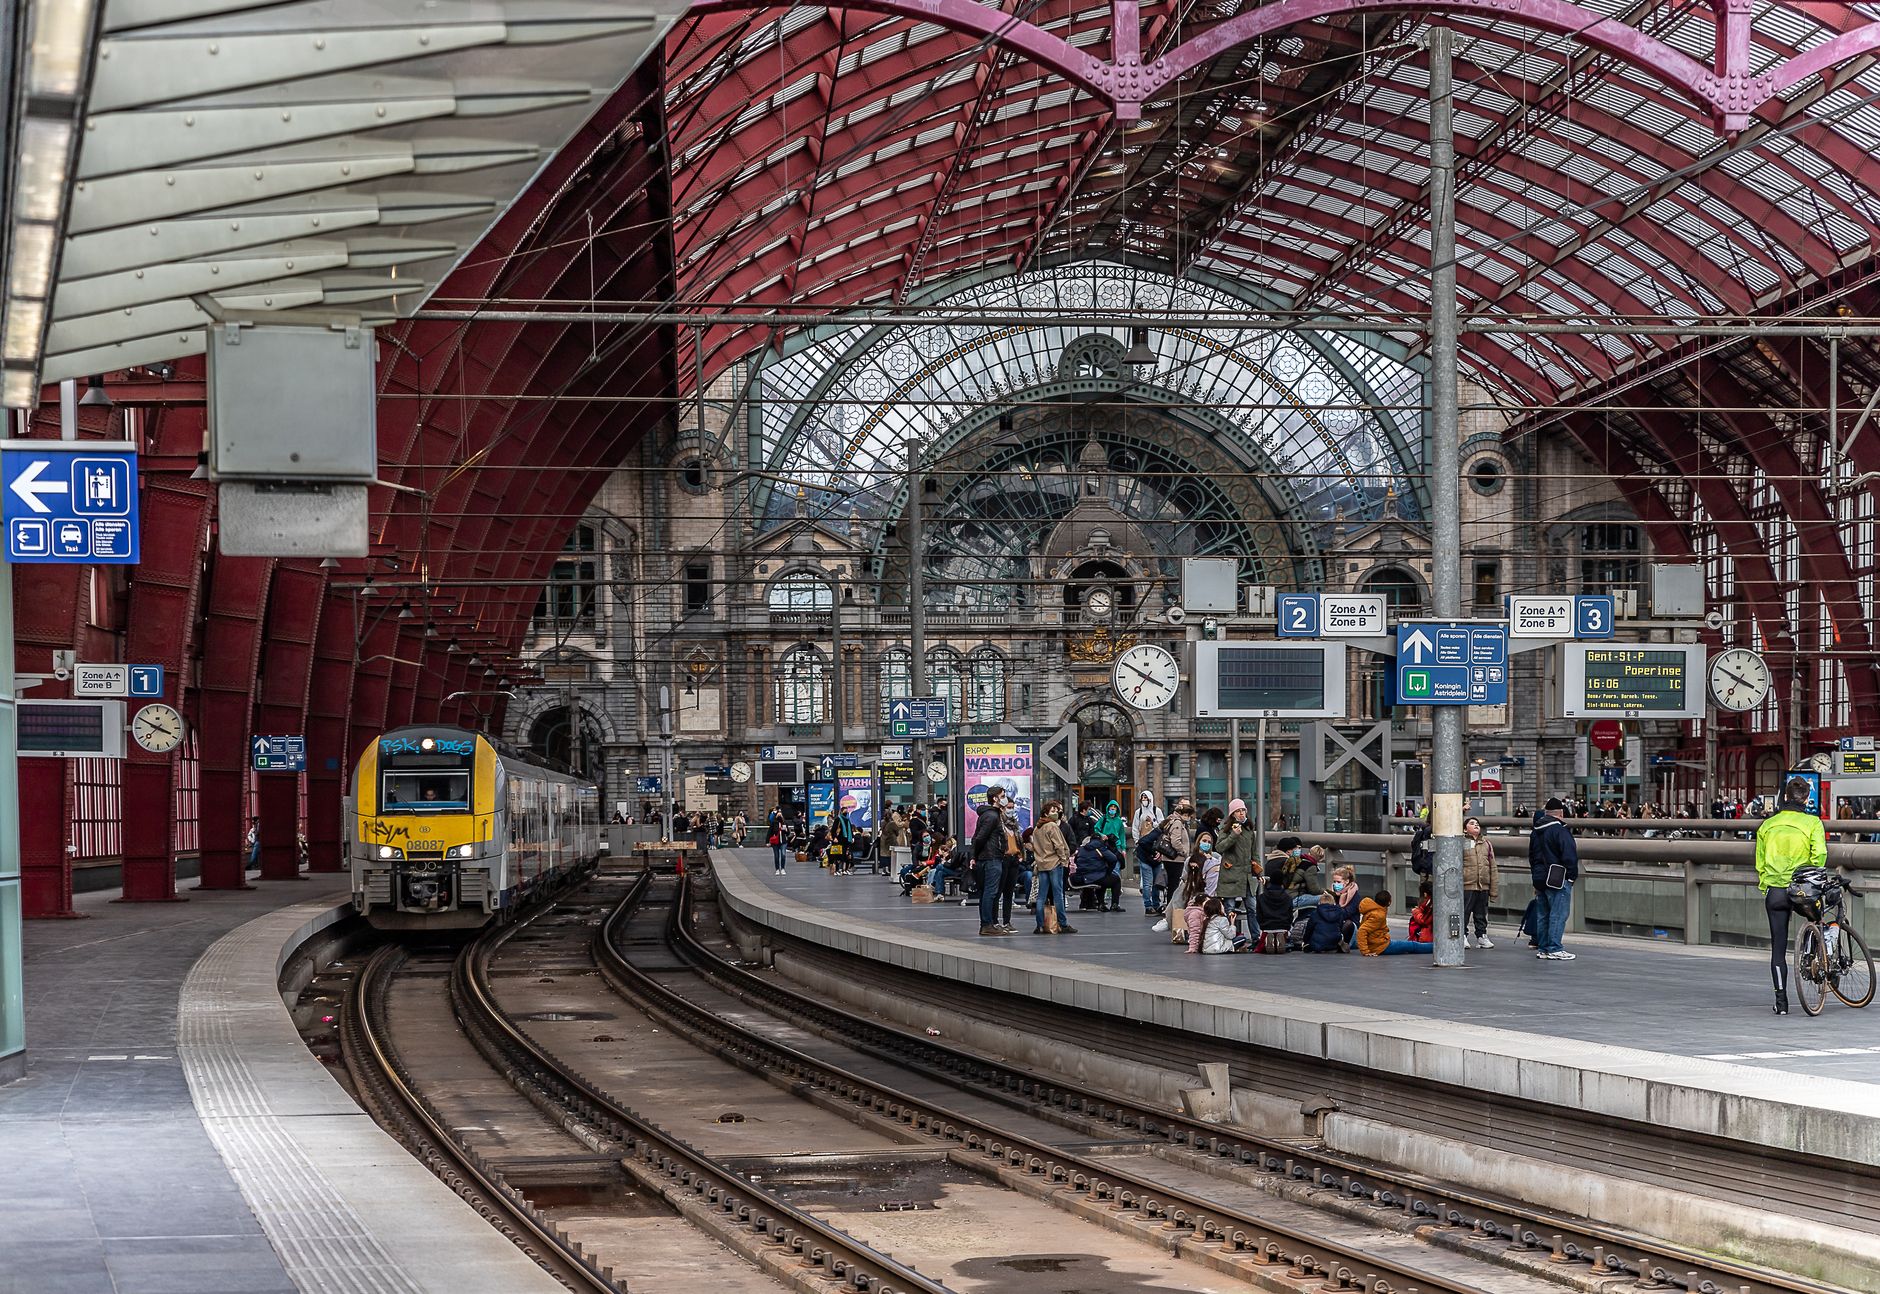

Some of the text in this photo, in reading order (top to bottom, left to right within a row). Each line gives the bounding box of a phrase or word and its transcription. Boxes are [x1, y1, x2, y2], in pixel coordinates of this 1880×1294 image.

[1330, 604, 1366, 613] Zone A
[1520, 606, 1555, 615] Zone A
[1292, 608, 1306, 628] 2
[1330, 618, 1355, 626] Zone
[1588, 609, 1601, 630] 3
[1520, 619, 1545, 627] Zone
[1588, 652, 1644, 661] Gent-St-P
[1625, 666, 1681, 675] Poperinge
[140, 675, 148, 691] 1
[1588, 679, 1680, 688] 16:06 IC
[966, 758, 1032, 769] WARHOL
[406, 840, 445, 850] 08087
